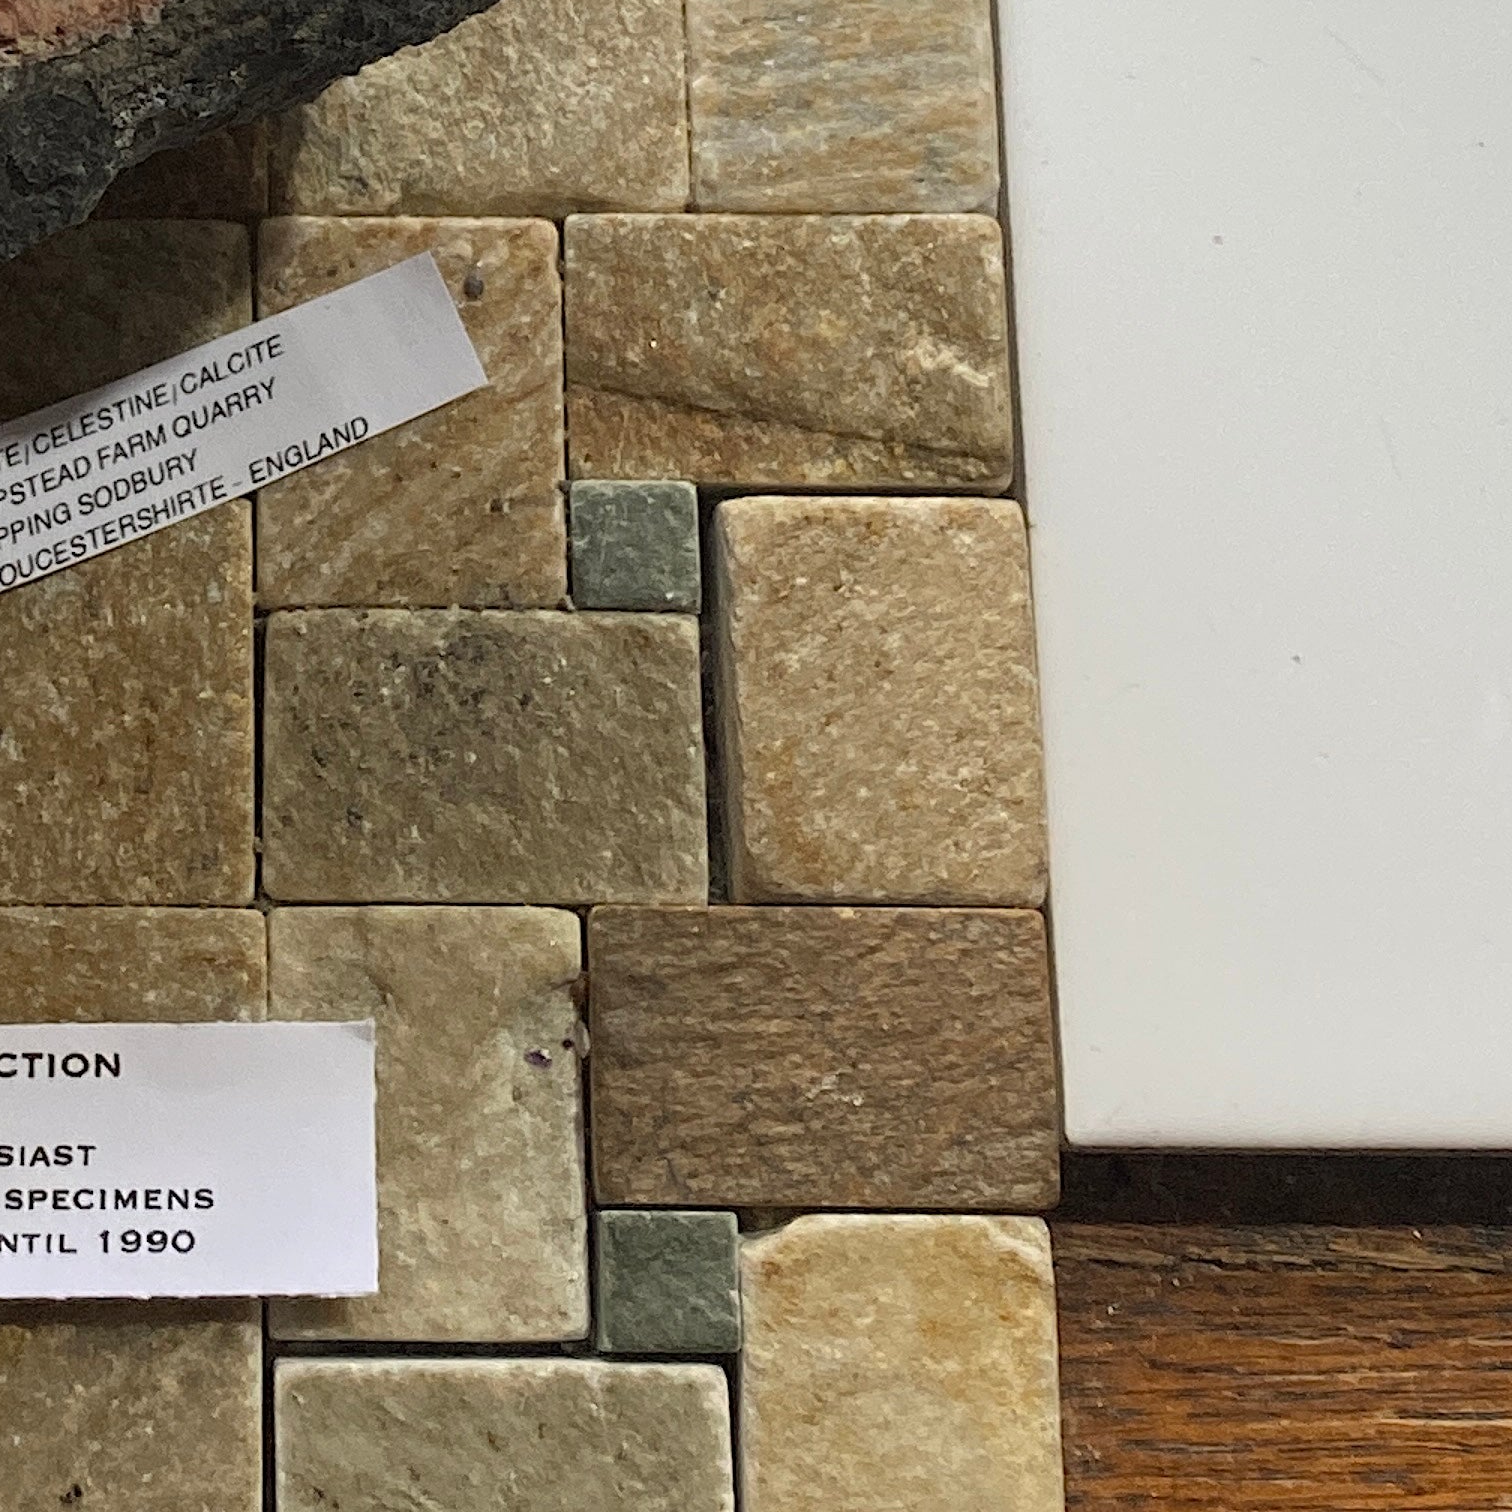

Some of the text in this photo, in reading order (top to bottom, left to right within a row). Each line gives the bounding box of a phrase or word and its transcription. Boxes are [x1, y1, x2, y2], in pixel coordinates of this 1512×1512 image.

[97, 427, 167, 471] FARM
[172, 377, 279, 438] QUARRY
[249, 416, 370, 486] ENGLAND
[78, 449, 200, 517] SODBURY
[4, 1187, 215, 1210] SPECIMENS
[99, 1229, 195, 1254] 1990
